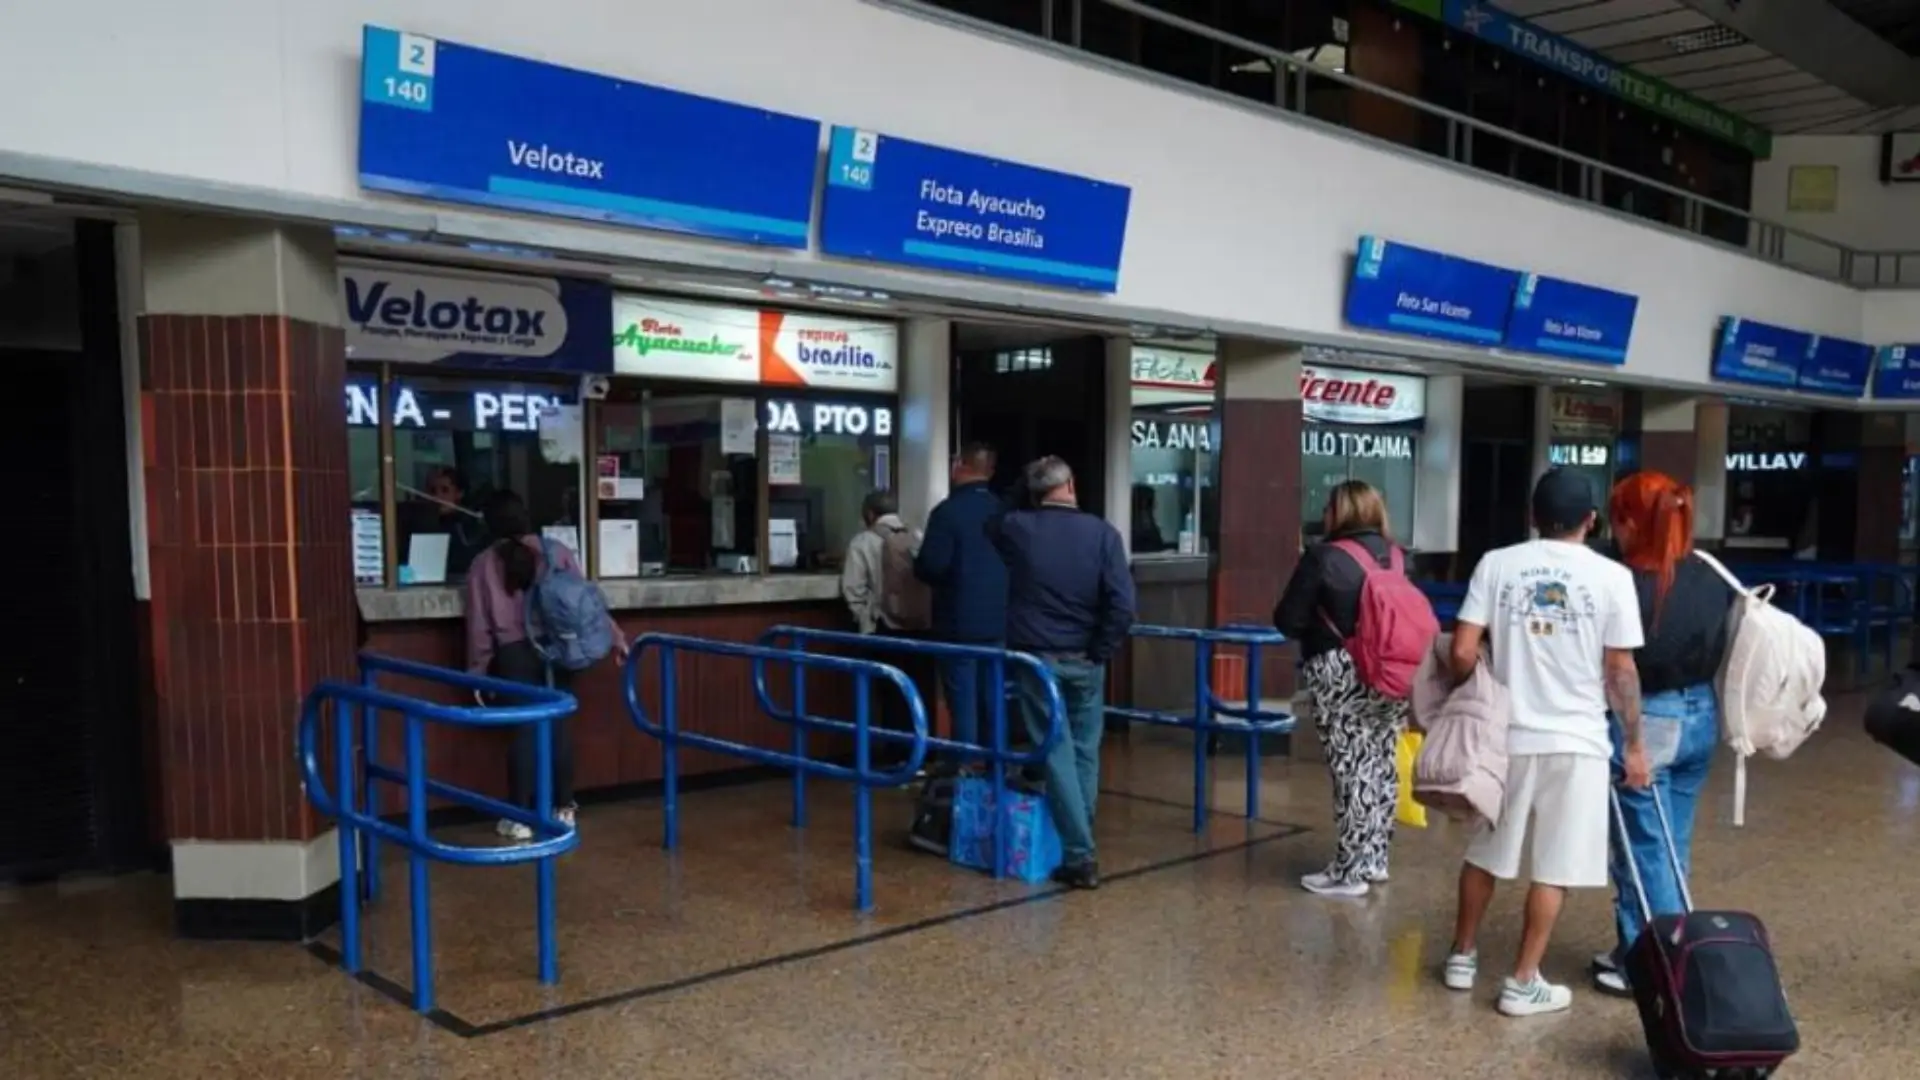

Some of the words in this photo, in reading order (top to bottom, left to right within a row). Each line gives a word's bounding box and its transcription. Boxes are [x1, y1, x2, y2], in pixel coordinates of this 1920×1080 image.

[409, 44, 425, 66] 2
[1508, 22, 1656, 104] TRANSPORTES
[384, 77, 426, 103] 140
[507, 139, 604, 180] Velotax
[859, 137, 873, 155] 2
[842, 163, 870, 185] 140
[920, 179, 963, 206] Flota
[967, 189, 1046, 221] Ayacucho
[916, 210, 983, 240] Expreso
[344, 276, 545, 338] Velotax
[797, 341, 875, 369] brasilia
[813, 403, 868, 435] PTO
[873, 406, 892, 436] B
[1131, 420, 1160, 450] SA
[1724, 452, 1805, 471] VILLAV
